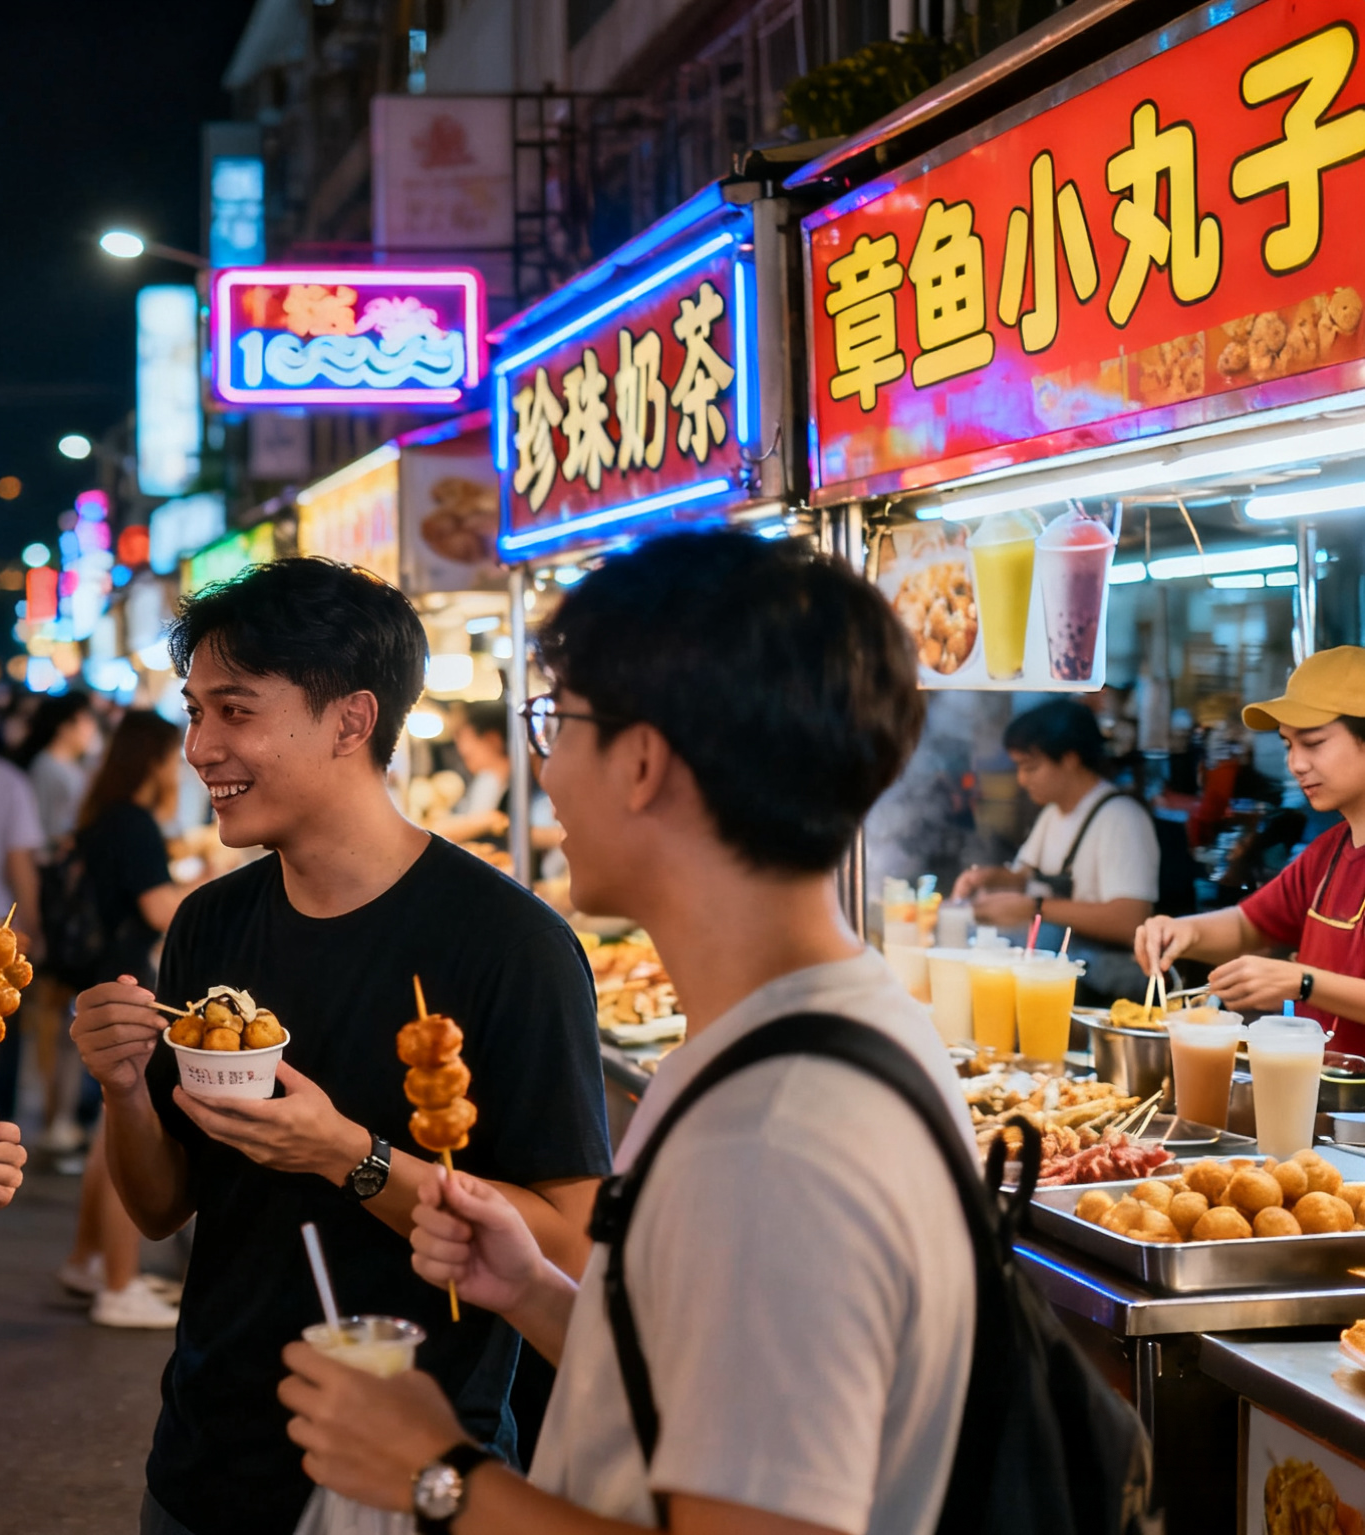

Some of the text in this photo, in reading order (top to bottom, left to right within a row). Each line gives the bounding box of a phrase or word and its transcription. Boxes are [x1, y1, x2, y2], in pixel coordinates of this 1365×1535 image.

[825, 19, 1365, 414] 章鱼小丸子
[512, 280, 735, 514] 珍珠奶茶
